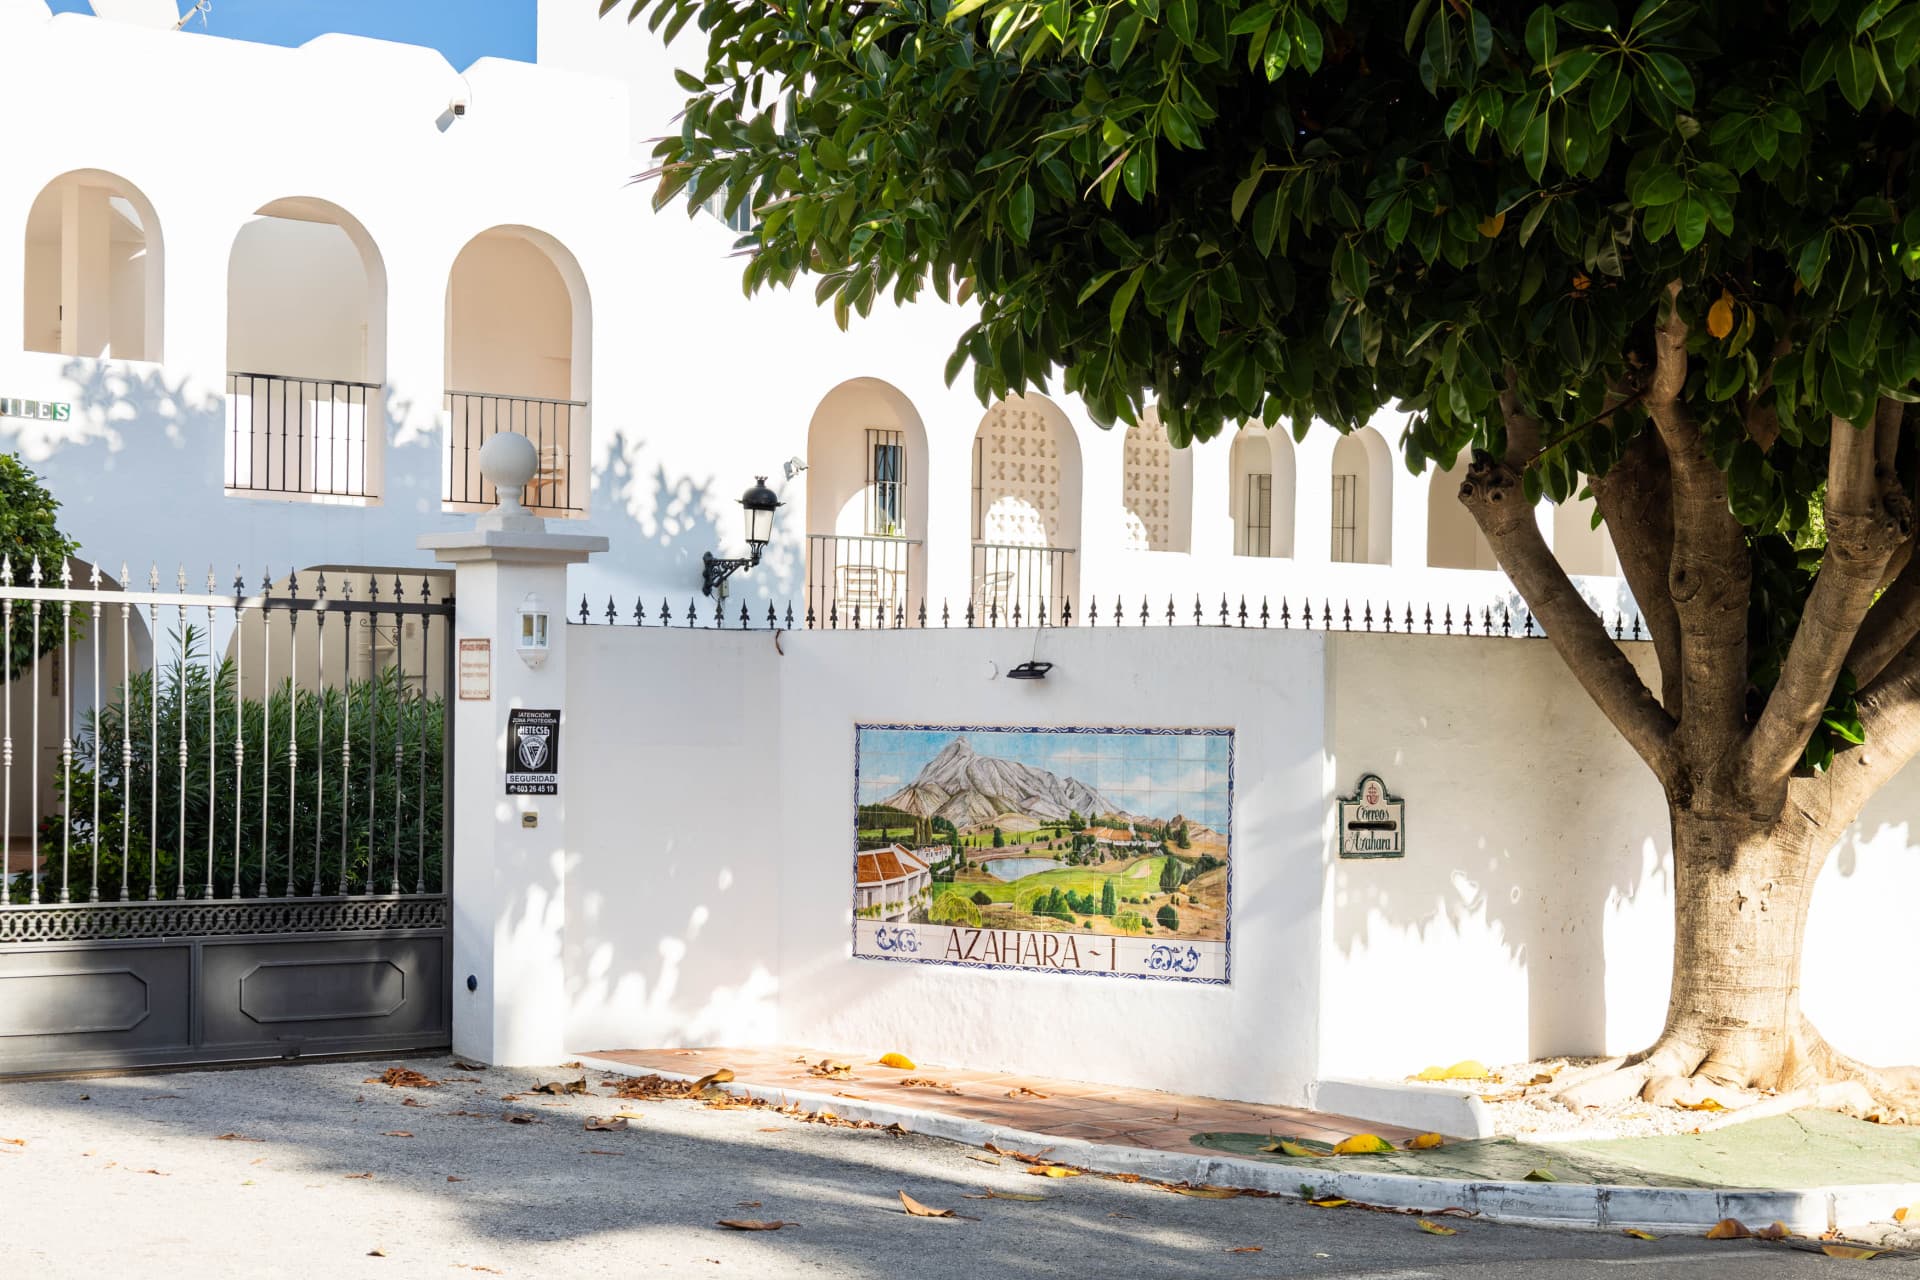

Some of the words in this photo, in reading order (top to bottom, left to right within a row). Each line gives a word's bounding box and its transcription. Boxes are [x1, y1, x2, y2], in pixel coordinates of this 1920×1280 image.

[509, 775, 556, 783] SEGURIDAD
[517, 785, 528, 793] 603
[529, 785, 537, 793] 26
[538, 785, 546, 793] 45
[1356, 806, 1390, 821] Correos
[1345, 830, 1391, 852] Azahara
[944, 928, 1081, 968] AZAHARA
